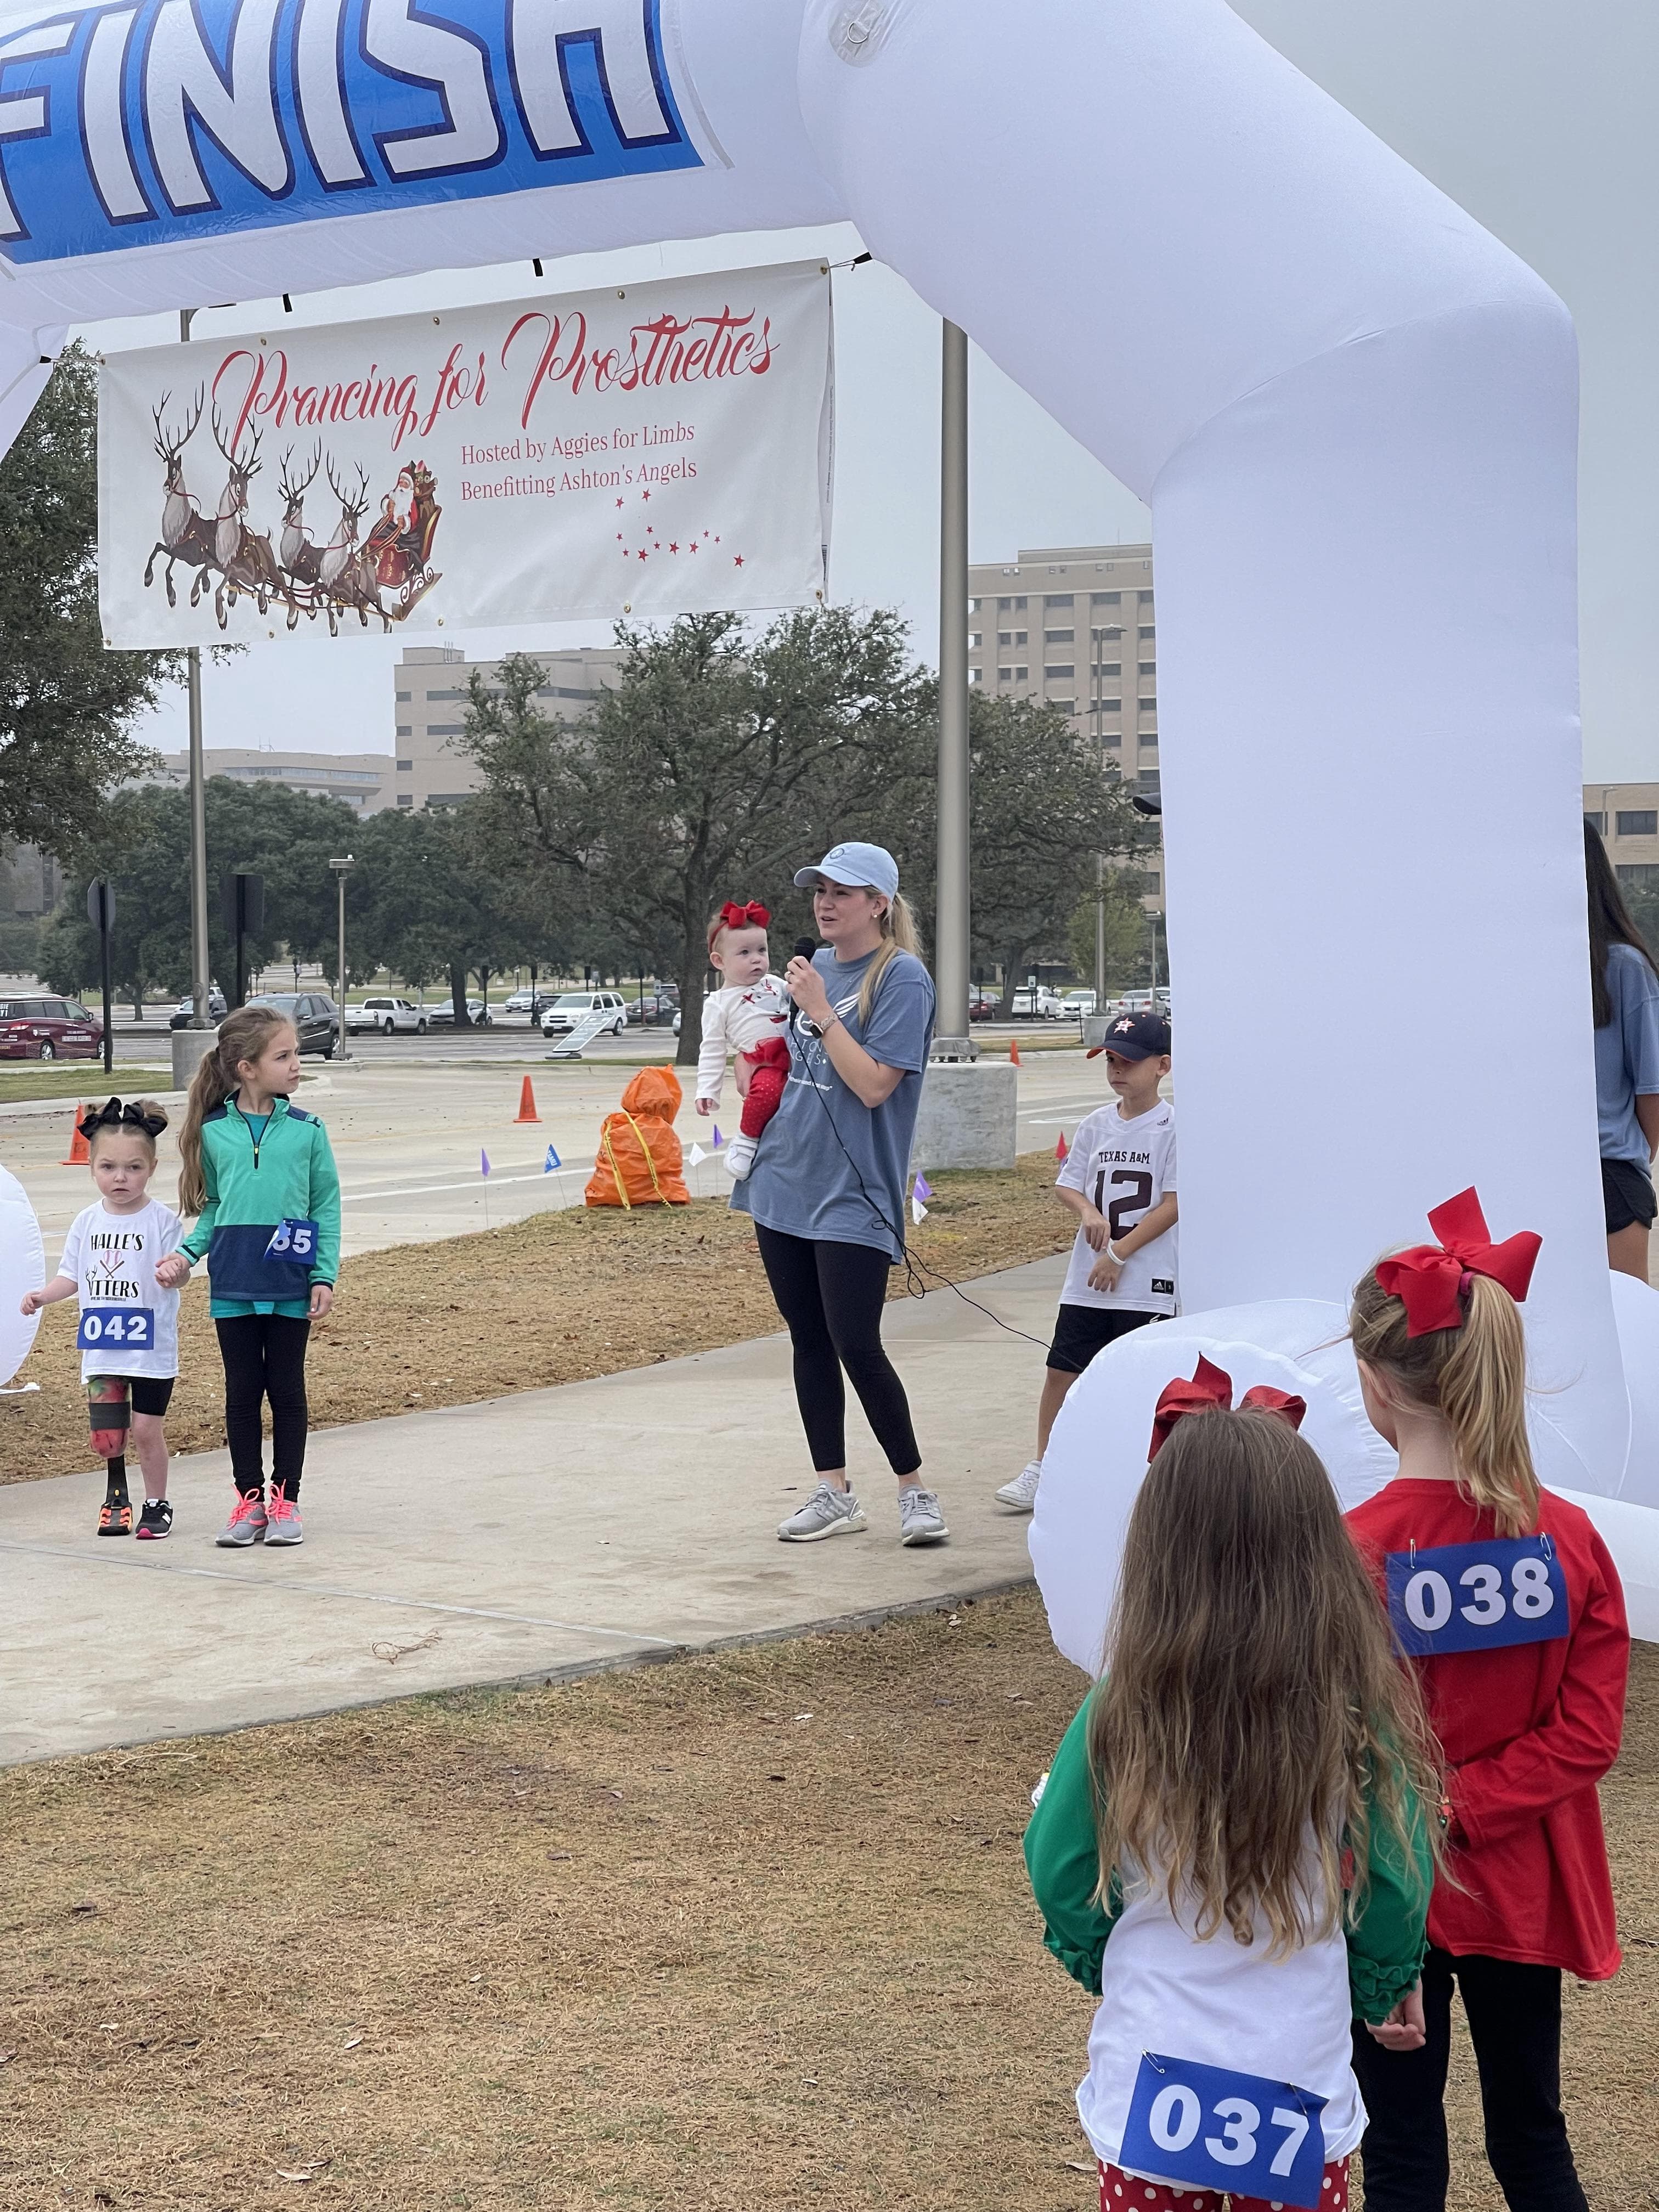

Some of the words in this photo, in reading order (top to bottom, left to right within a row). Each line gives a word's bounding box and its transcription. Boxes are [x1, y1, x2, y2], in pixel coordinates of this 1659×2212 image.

[0, 0, 681, 242] FINISH
[212, 350, 418, 459] Prancing
[419, 343, 488, 437] for
[501, 305, 781, 430] Prosthetics
[461, 439, 521, 465] Hosted
[526, 438, 546, 462] by
[551, 433, 608, 459] Aggies
[612, 428, 638, 449] for
[642, 421, 695, 445] Limbs
[461, 474, 556, 500] Benefitting
[559, 464, 633, 492] Ashton's
[636, 456, 697, 484] Angels
[1098, 1151, 1127, 1163] TEXAS
[1129, 1152, 1150, 1164] A&M
[1094, 1170, 1153, 1240] 12
[91, 1233, 144, 1251] HALLE'S
[84, 1316, 147, 1341] 042
[1404, 1557, 1554, 1632] 038
[1149, 2084, 1310, 2177] 037
